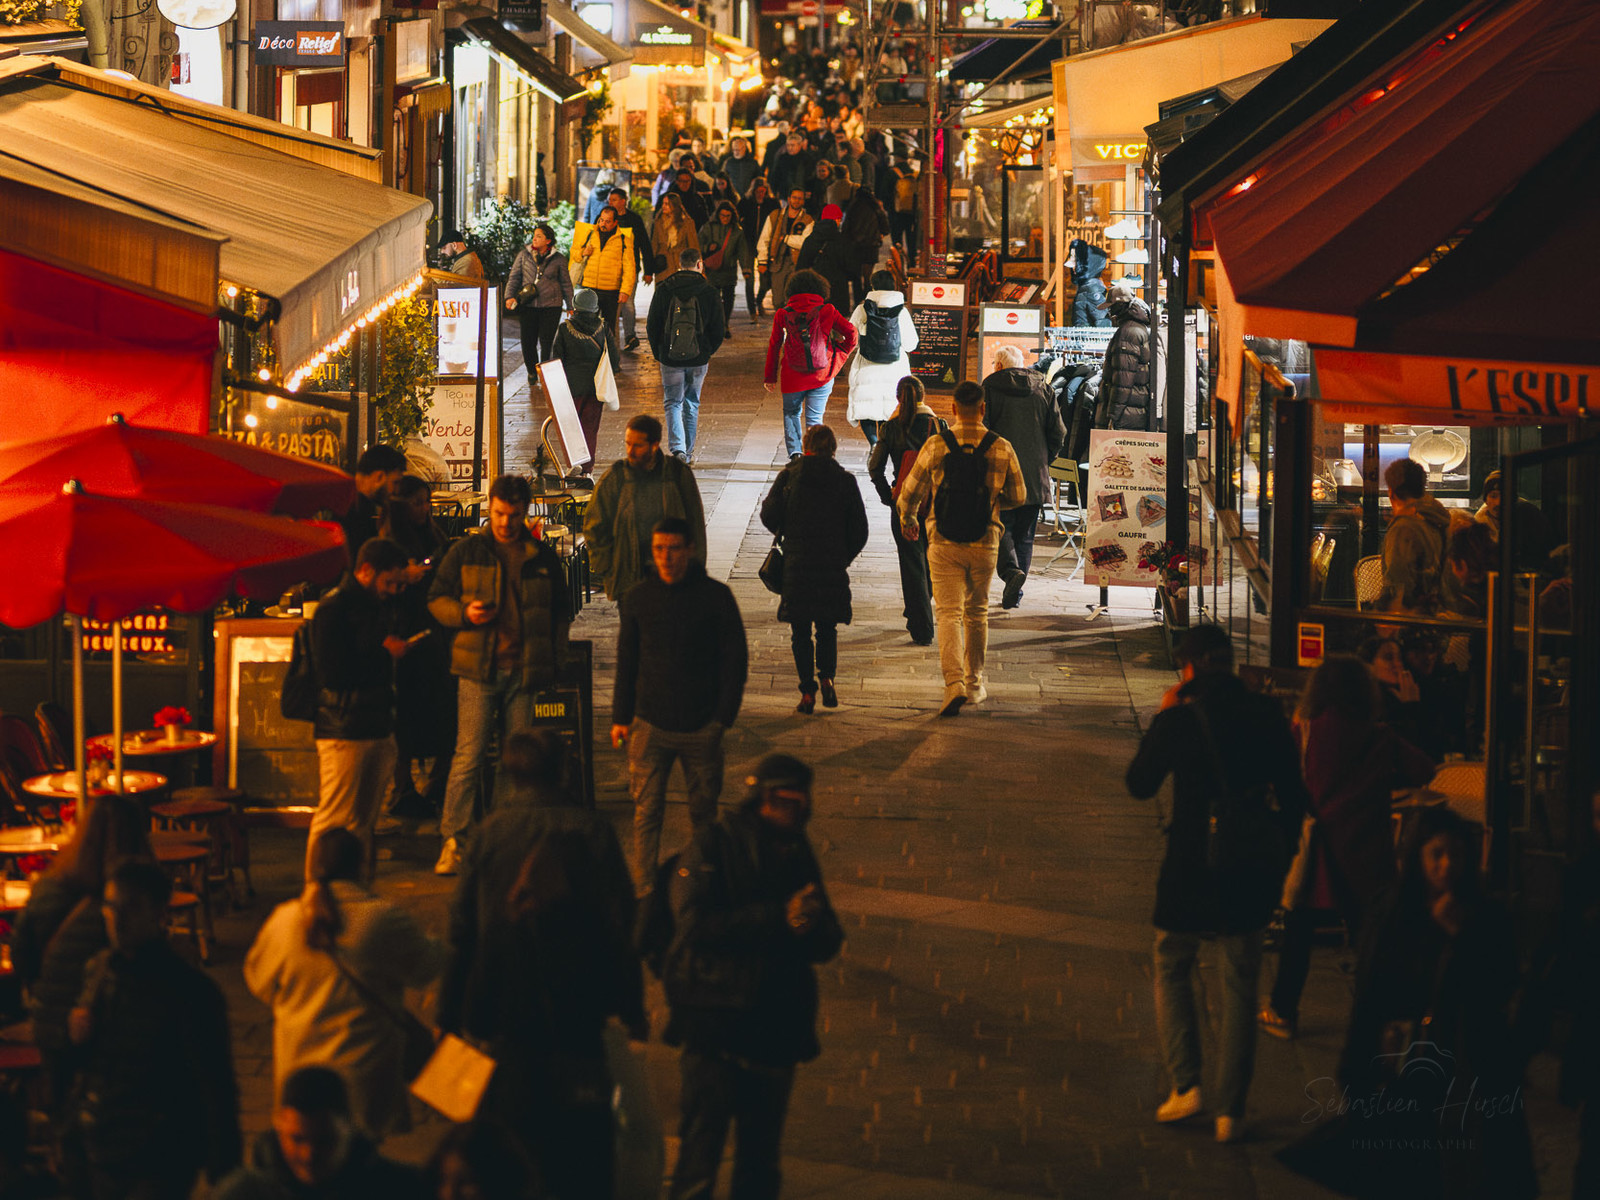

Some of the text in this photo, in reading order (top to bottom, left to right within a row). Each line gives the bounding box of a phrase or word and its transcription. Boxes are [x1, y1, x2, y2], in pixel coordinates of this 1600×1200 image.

[258, 32, 341, 54] Déco Relief
[428, 418, 476, 438] Vente
[279, 432, 336, 458] PASTA
[1118, 531, 1147, 539] GAUFRE
[534, 703, 566, 718] HOUR
